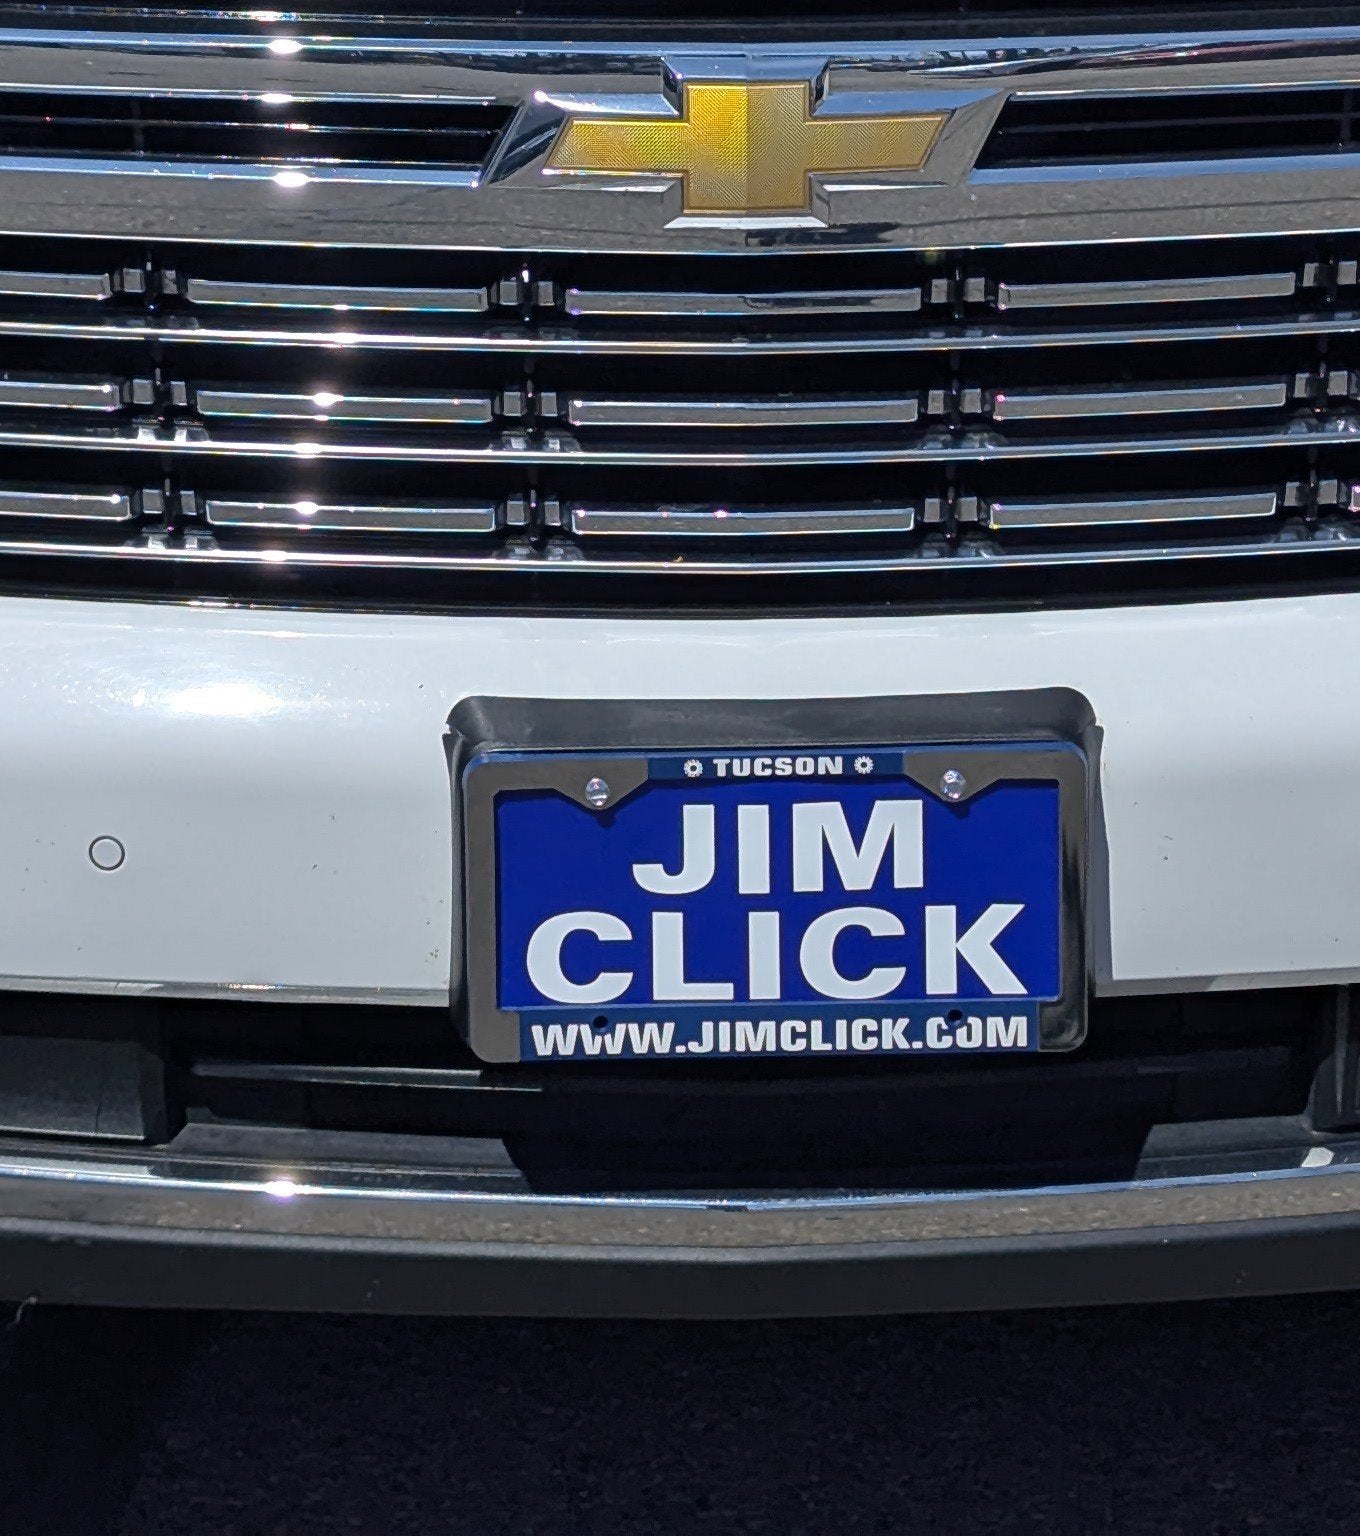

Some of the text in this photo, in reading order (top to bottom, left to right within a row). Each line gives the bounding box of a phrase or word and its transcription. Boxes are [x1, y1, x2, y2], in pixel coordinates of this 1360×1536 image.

[713, 756, 843, 778] TUCSON
[632, 799, 924, 895] JIM
[526, 903, 1029, 1004] CLICK
[531, 1015, 1028, 1057] WWW.JIMCLICK.COM
